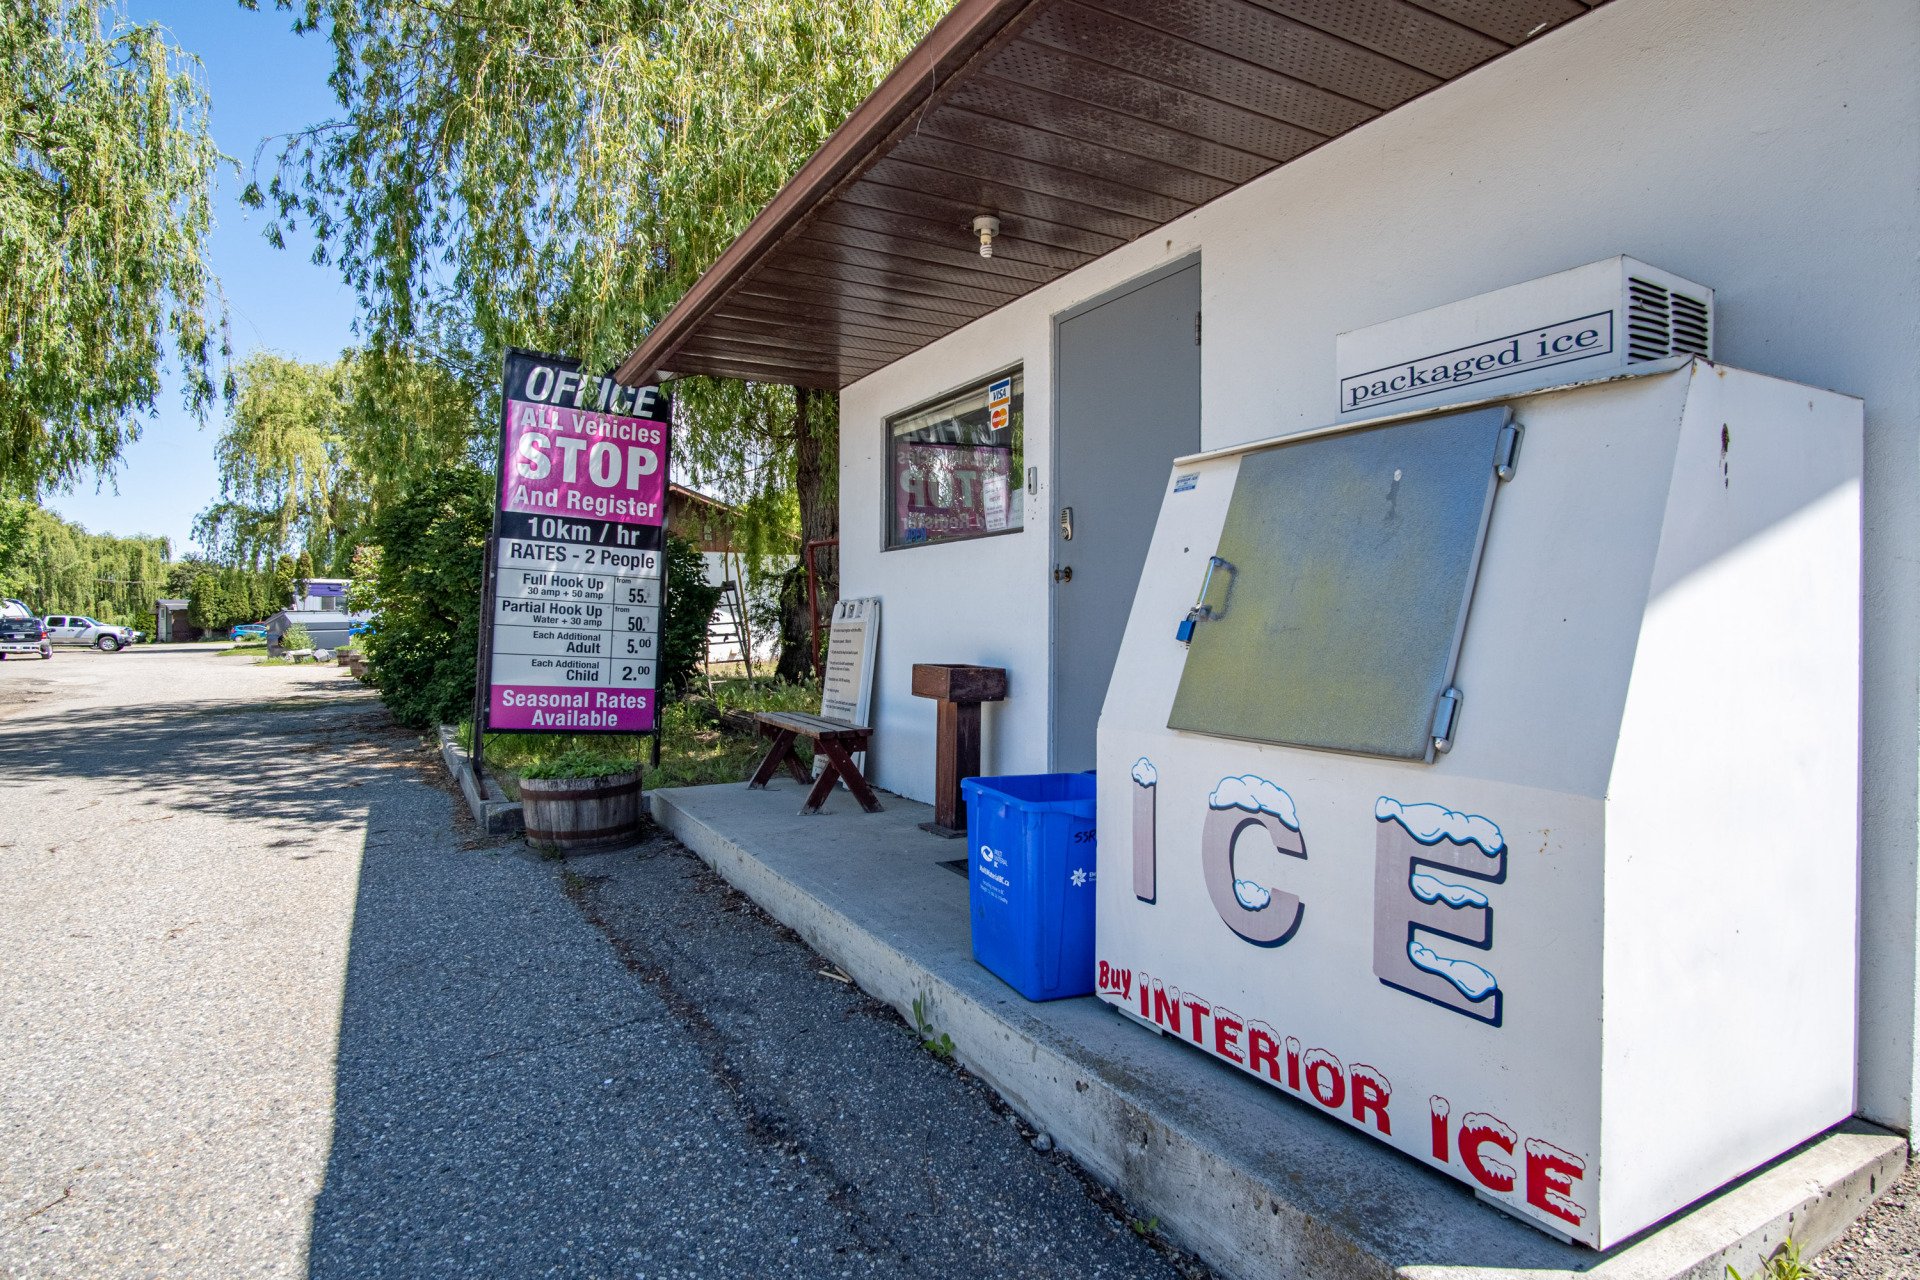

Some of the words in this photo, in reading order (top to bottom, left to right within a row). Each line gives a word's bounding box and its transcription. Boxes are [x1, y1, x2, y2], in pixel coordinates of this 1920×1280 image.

[1349, 340, 1520, 407] packaged
[1536, 329, 1599, 358] ice
[525, 366, 659, 418] OFFICE
[993, 388, 1007, 401] VISA
[521, 407, 564, 431] ALL
[572, 413, 661, 445] Vehicles
[517, 431, 659, 491] STOP
[513, 484, 558, 508] And
[567, 490, 658, 518] Register
[528, 516, 592, 542] 10km
[617, 525, 640, 546] hr
[510, 542, 567, 562] RATES
[585, 548, 595, 565] 2
[601, 551, 655, 571] People
[523, 573, 547, 586] Full
[551, 574, 584, 589] Hook
[587, 578, 604, 592] Up
[527, 587, 539, 595] 30
[540, 589, 560, 598] amp
[571, 590, 583, 598] 50
[584, 591, 604, 600] amp
[502, 600, 545, 614] Partial
[550, 602, 582, 616] Hook
[586, 605, 603, 619] Up
[533, 615, 558, 625] Water
[570, 617, 581, 625] 30
[583, 618, 602, 627] amp
[533, 630, 555, 640] Each
[556, 632, 601, 642] Additional
[566, 642, 601, 654] Adult
[531, 659, 553, 668] Each
[555, 660, 600, 669] Additional
[566, 669, 599, 682] Child
[502, 689, 589, 708] Seasonal
[596, 691, 647, 709] Rates
[531, 709, 618, 727] Available
[1131, 757, 1508, 1029] ICE
[1098, 960, 1132, 1000] Buy
[1138, 971, 1393, 1137] INTERIOR
[1429, 1095, 1586, 1228] ICE
